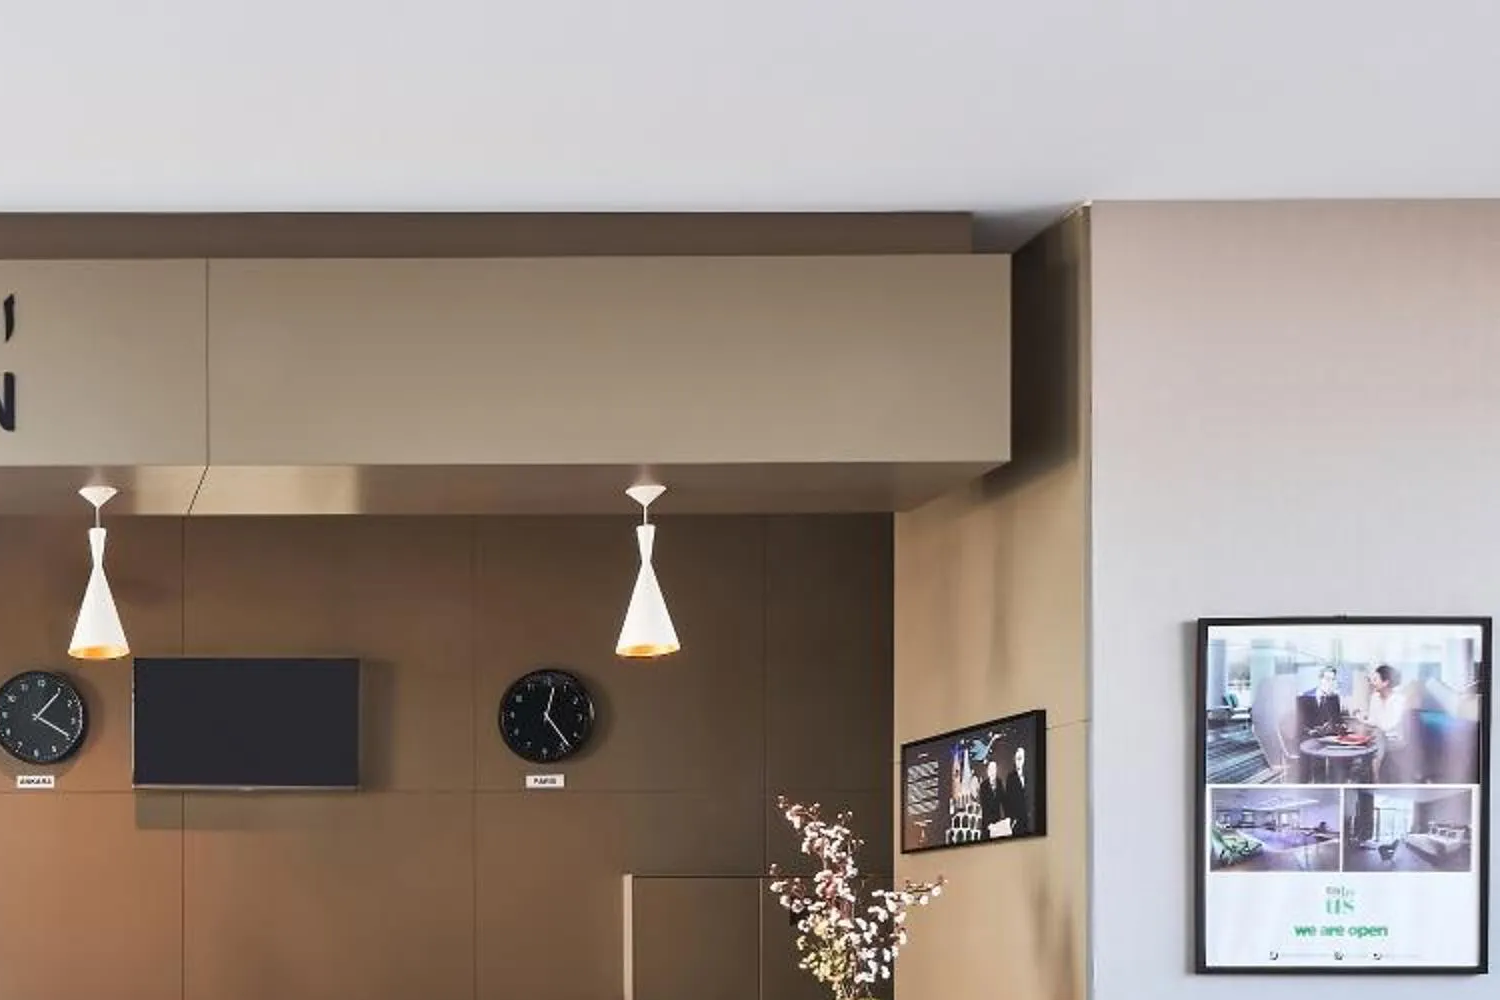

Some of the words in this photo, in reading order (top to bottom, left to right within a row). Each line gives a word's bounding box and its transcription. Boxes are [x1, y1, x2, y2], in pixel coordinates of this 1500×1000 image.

[1293, 925, 1316, 937] we
[1320, 925, 1345, 937] are
[1347, 925, 1389, 939] open
